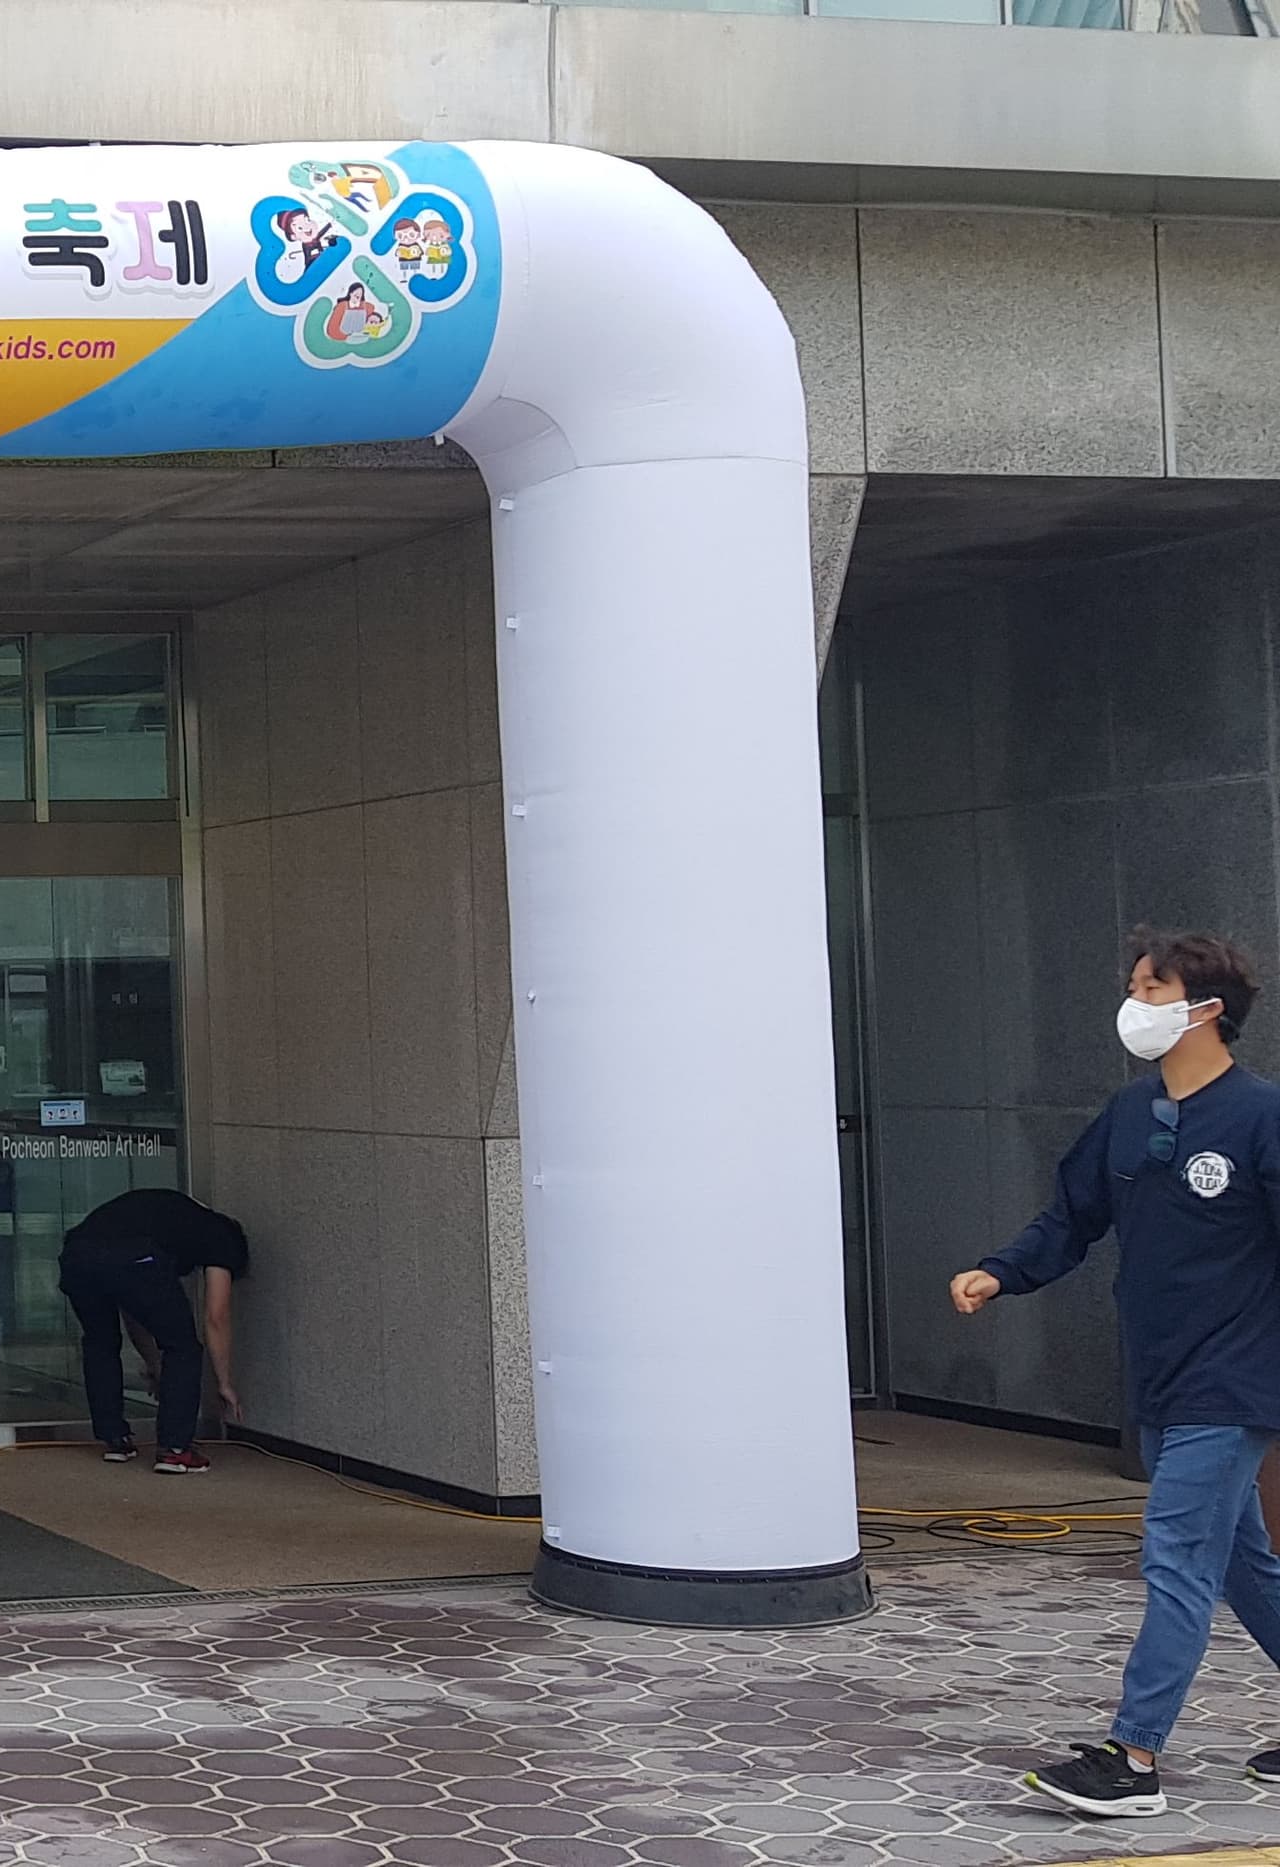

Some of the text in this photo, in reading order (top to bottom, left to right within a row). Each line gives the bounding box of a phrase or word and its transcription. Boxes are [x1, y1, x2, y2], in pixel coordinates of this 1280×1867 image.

[23, 197, 209, 289] 축제
[1, 1134, 161, 1160] Pocheon Banweol Art Hall
